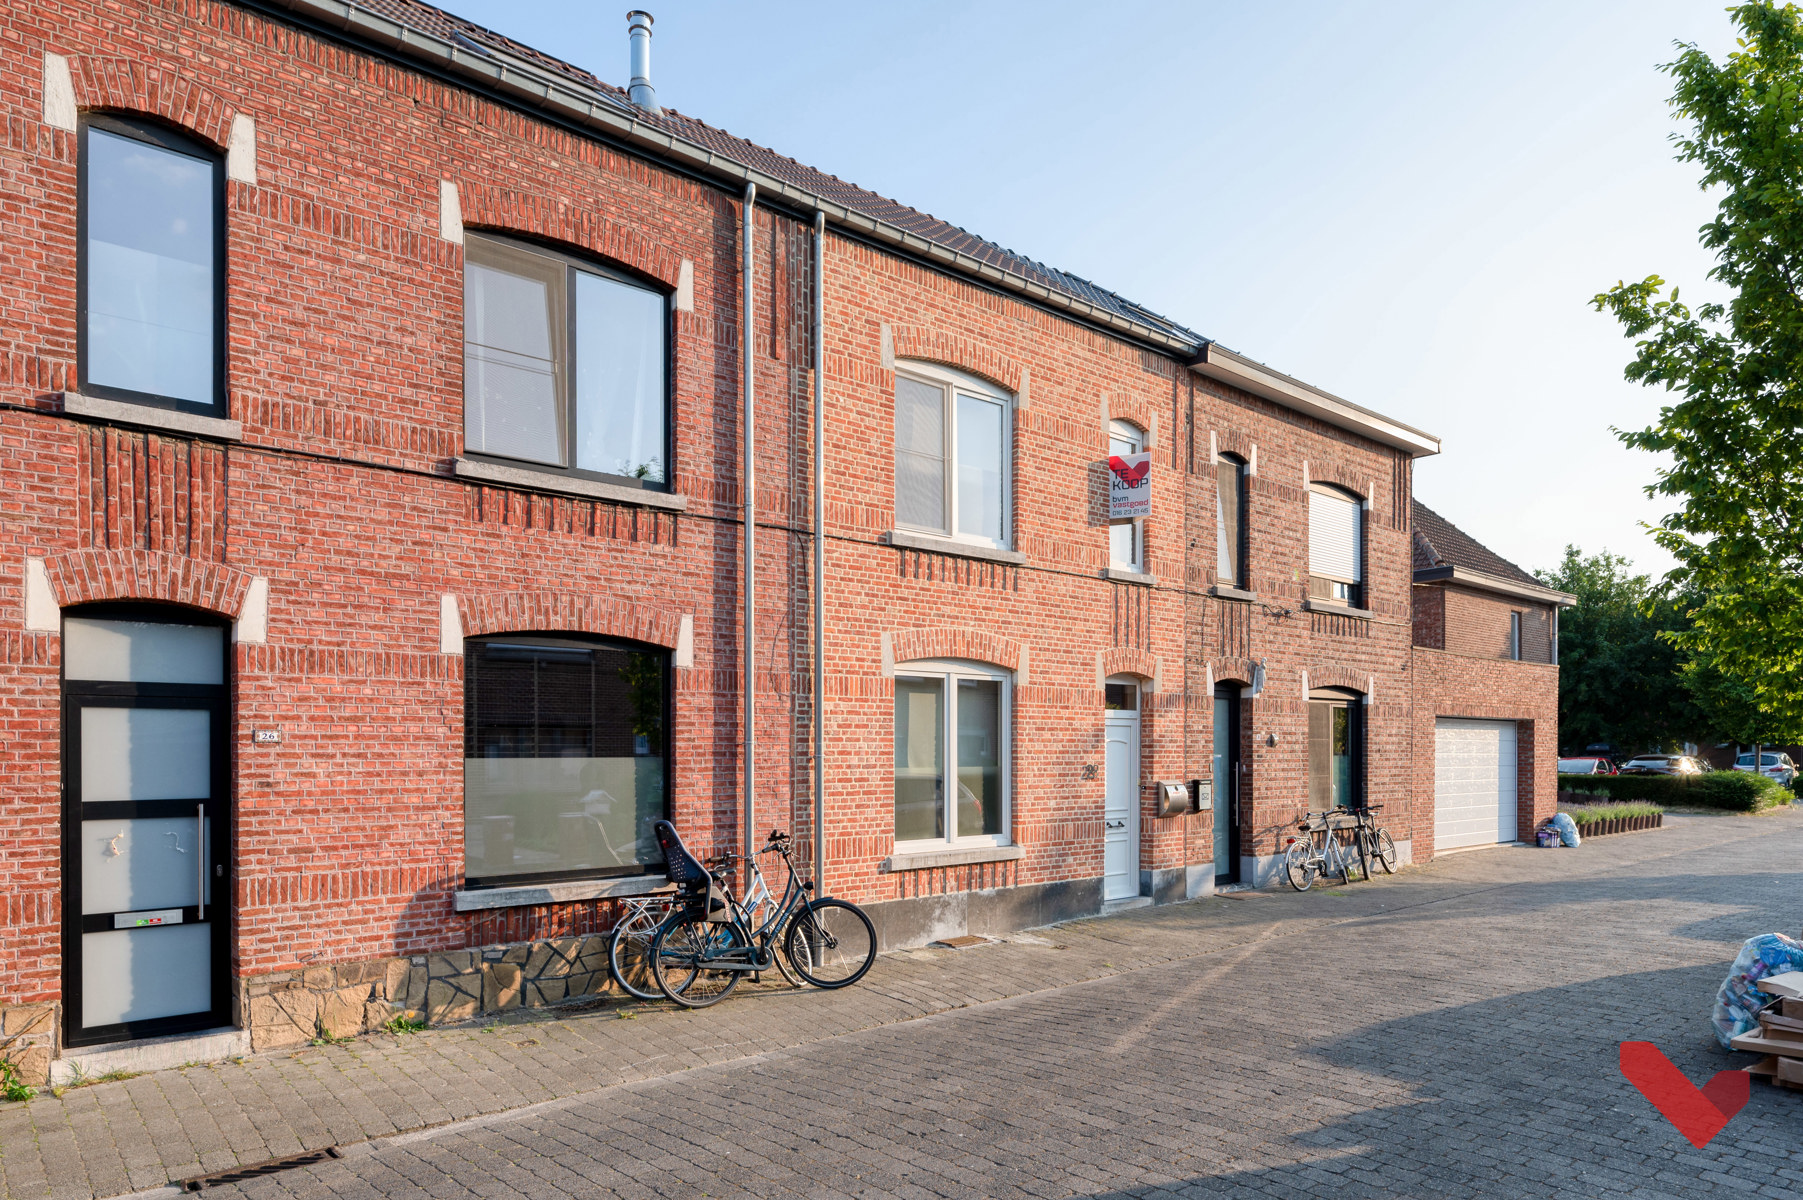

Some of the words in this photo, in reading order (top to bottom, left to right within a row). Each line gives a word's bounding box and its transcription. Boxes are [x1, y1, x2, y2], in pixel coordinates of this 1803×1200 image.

[1114, 468, 1129, 480] TE
[1112, 477, 1149, 491] KOOP
[1112, 499, 1149, 509] vastgoed
[262, 732, 275, 740] 26
